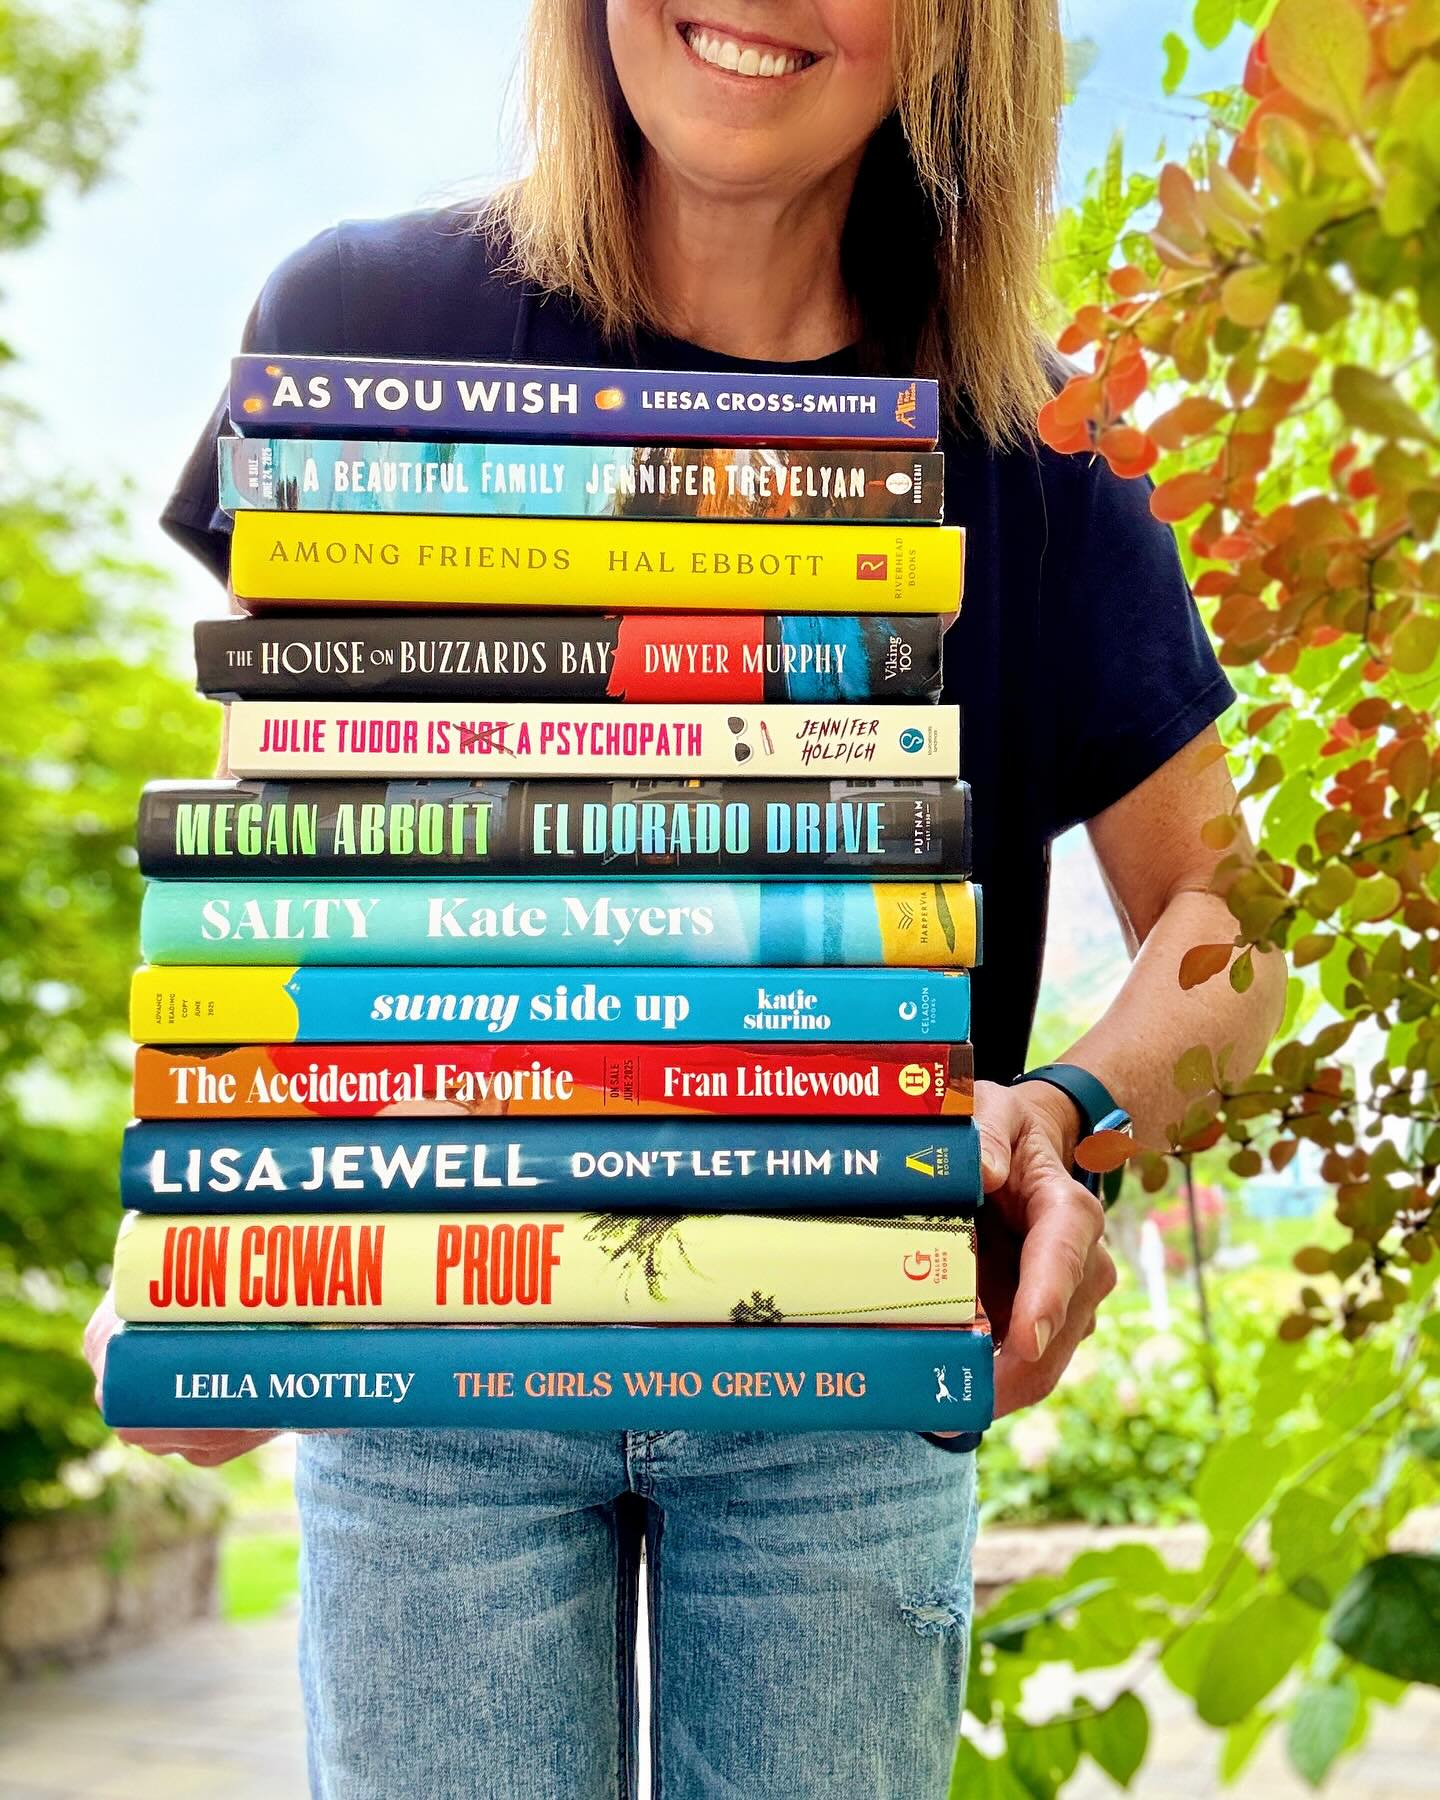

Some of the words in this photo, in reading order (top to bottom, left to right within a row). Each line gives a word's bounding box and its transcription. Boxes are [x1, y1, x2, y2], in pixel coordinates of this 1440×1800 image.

[272, 376, 331, 409] AS
[345, 378, 442, 410] YOU
[457, 380, 578, 414] WISH
[642, 391, 710, 410] LEESA
[716, 393, 876, 413] CROSS-SMITH
[303, 458, 320, 493] A
[334, 460, 469, 494] BEAUTIFUL
[482, 462, 565, 494] FAMILY
[585, 463, 716, 496] JENNIFER
[724, 465, 866, 498] TREVELYAN
[913, 463, 922, 504] DOUBLEDAY
[269, 541, 400, 565] AMONG
[418, 545, 571, 570] FRIENDS
[608, 550, 674, 573] HAL
[691, 552, 823, 576] EBBOTT
[895, 537, 903, 599] RIVERHEAD
[908, 549, 916, 587] BOOKS
[227, 650, 253, 667] THE
[262, 641, 365, 674] HOUSE
[370, 649, 394, 666] ON
[400, 641, 547, 674] BUZZARDS
[562, 642, 612, 674] BAY
[645, 643, 729, 673] DWYER
[743, 643, 847, 674] MURPHY
[885, 636, 902, 680] Viking
[900, 644, 912, 673] 100
[259, 719, 327, 752] JULIE
[336, 720, 418, 753] TUDOR
[428, 721, 451, 754] IS
[517, 722, 531, 755] A
[540, 722, 702, 756] PSYCHOPATH
[796, 717, 880, 740] JENNIFER
[801, 742, 876, 766] HOLDICH
[175, 804, 318, 856] MEGAN
[334, 803, 493, 856] ABBOTT
[533, 803, 574, 856] EL
[582, 803, 750, 855] DORADO
[767, 803, 886, 854] DRIVE
[914, 800, 923, 854] PUTNAM
[201, 898, 382, 940] SALTY
[426, 897, 547, 937] Kate
[561, 897, 714, 946] Myers
[370, 993, 520, 1033] sunny
[530, 984, 622, 1021] side
[635, 994, 690, 1030] up
[757, 988, 818, 1010] katie
[921, 987, 929, 1034] CELADON
[743, 1012, 832, 1031] sturino
[168, 1066, 237, 1104] The
[246, 1063, 424, 1104] Accidental
[435, 1061, 574, 1102] Favorite
[609, 1063, 619, 1085] SALE
[623, 1060, 633, 1081] 2025
[663, 1066, 728, 1097] Fran
[736, 1064, 880, 1097] Littlewood
[934, 1062, 945, 1097] HOLT
[610, 1085, 620, 1098] ON
[624, 1081, 633, 1101] JUNE
[151, 1147, 286, 1193] LISA
[302, 1144, 538, 1191] JEWELL
[572, 1151, 682, 1178] DON'T
[692, 1150, 756, 1176] LET
[767, 1150, 831, 1175] HIM
[844, 1149, 879, 1174] IN
[149, 1226, 230, 1308] JON
[240, 1225, 386, 1307] COWAN
[435, 1223, 565, 1306] PROOF
[175, 1374, 258, 1399] LEILA
[268, 1373, 415, 1403] MOTTLEY
[453, 1372, 514, 1398] THE
[525, 1372, 613, 1398] GIRLS
[623, 1372, 702, 1398] WHO
[712, 1371, 806, 1398] GREW
[815, 1372, 867, 1397] BIG
[962, 1365, 973, 1402] Knopf
